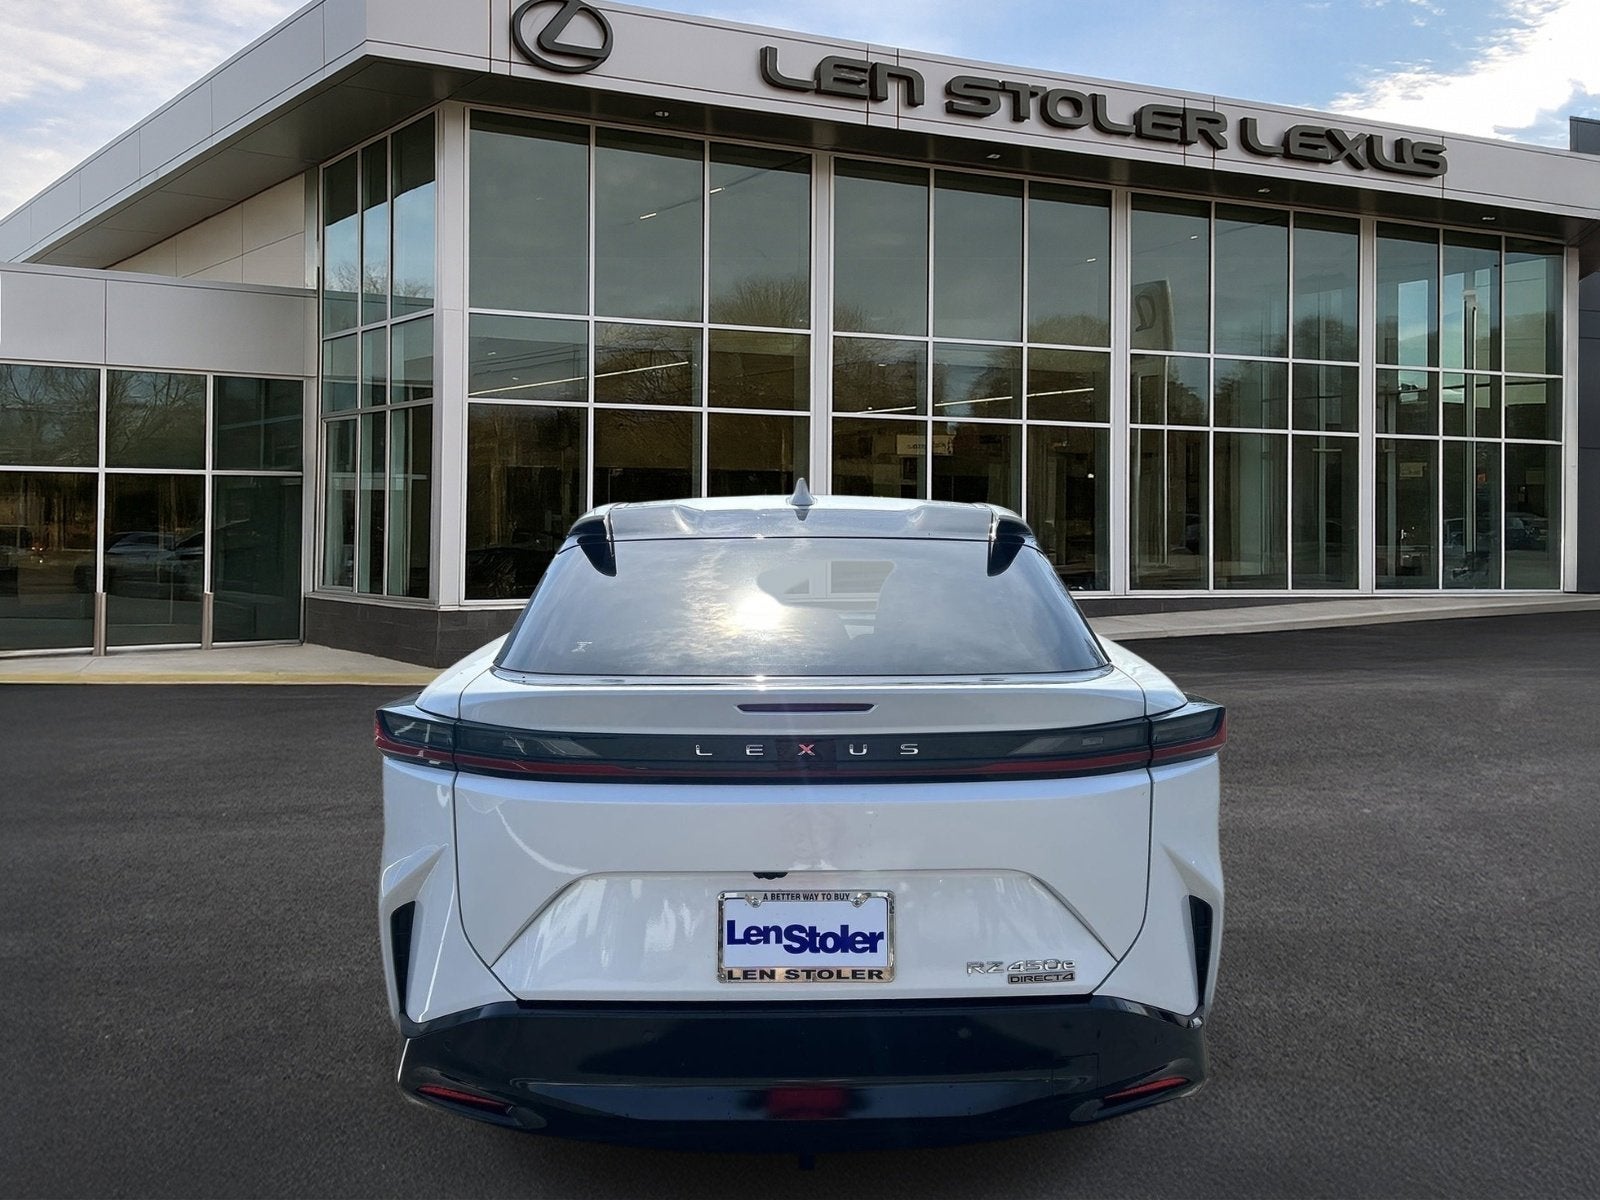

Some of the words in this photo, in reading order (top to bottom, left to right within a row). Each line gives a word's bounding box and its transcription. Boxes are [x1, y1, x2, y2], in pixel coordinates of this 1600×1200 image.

[945, 74, 1227, 150] STOLER
[1239, 116, 1448, 178] LEXUS
[695, 743, 919, 756] LEXUS
[771, 893, 800, 901] BETTER
[803, 893, 819, 901] WAY
[822, 893, 832, 901] TO
[834, 893, 850, 901] BUY
[967, 961, 1004, 974] RZ
[727, 969, 776, 980] LEN
[785, 969, 883, 980] STOLER
[1010, 972, 1074, 983] DIRECT4
